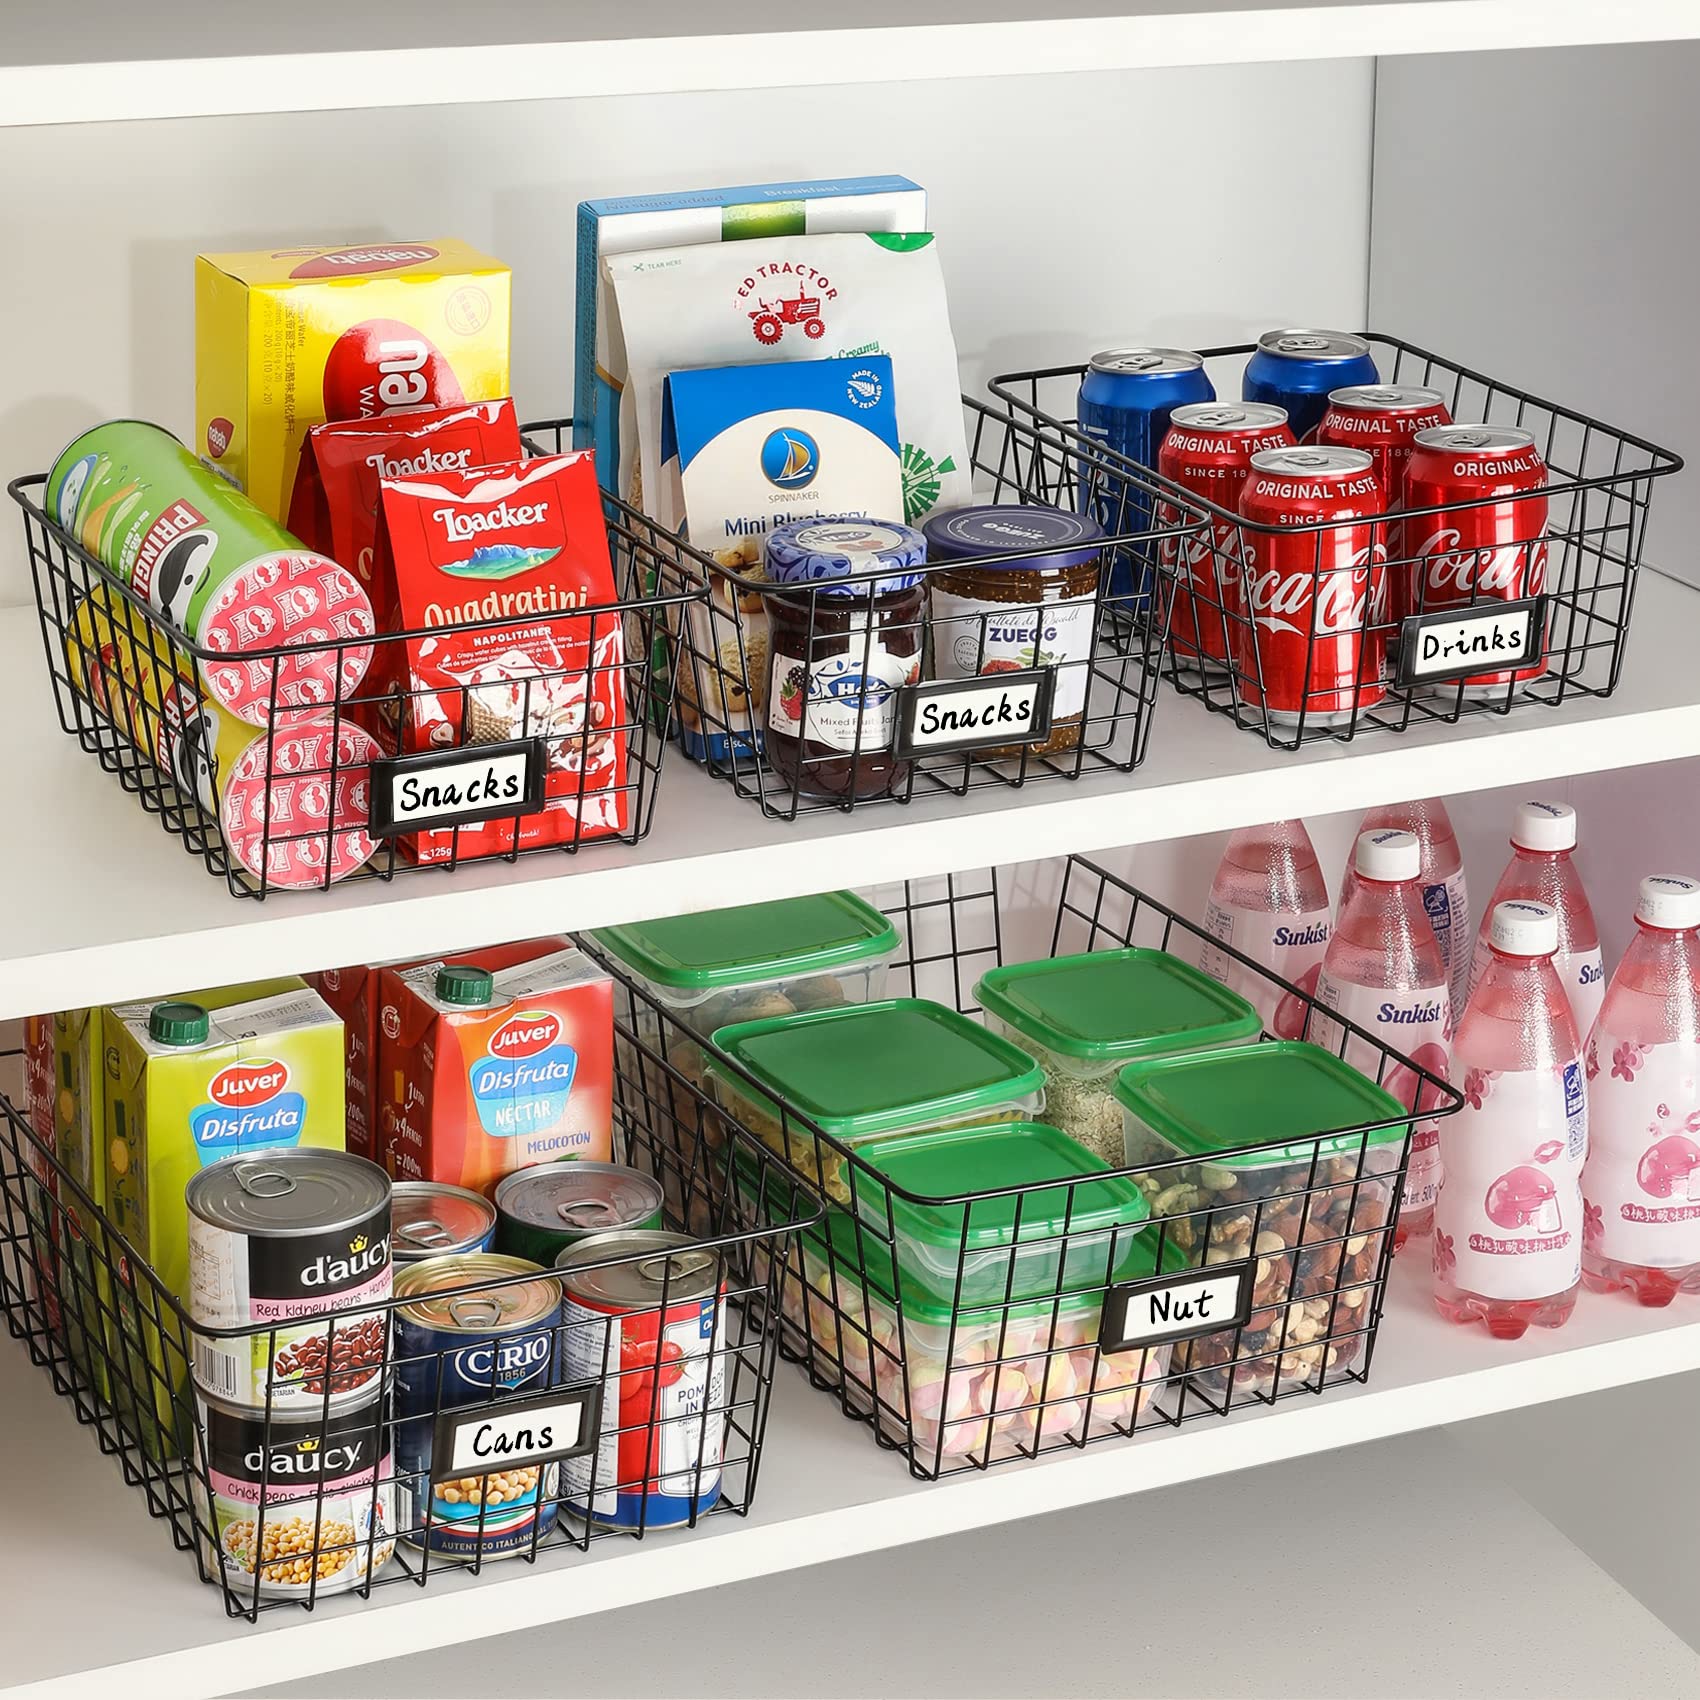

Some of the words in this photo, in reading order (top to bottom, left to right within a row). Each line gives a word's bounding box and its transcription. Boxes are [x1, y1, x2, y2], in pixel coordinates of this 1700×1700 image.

[756, 262, 838, 300] TRACTOR
[852, 370, 871, 379] MADE
[871, 374, 879, 382] IN
[859, 384, 882, 409] ZEALAND
[1325, 414, 1391, 433] ORIGINAL
[1396, 414, 1441, 433] TASTE
[1168, 433, 1236, 454] ORIGINAL
[1241, 434, 1287, 453] TASTE
[365, 448, 471, 477] Loacker
[1184, 467, 1225, 478] SINCE
[1453, 460, 1531, 476] ORIGINAL
[768, 491, 819, 504] SPINNAKER
[1256, 480, 1334, 499] ORIGINAL
[1337, 476, 1378, 497] TASTE
[433, 502, 548, 543] Loacker
[725, 516, 766, 537] Mini
[1280, 514, 1324, 524] SINCE
[133, 504, 199, 605] PRINGL
[424, 585, 588, 630] Quadratini
[473, 625, 552, 647] NAPOLITANER
[989, 627, 1058, 643] ZUEGG
[1422, 624, 1523, 661] Drinks
[820, 717, 850, 726] Mixed
[920, 692, 1031, 735] Snacks
[400, 767, 519, 811] Snacks
[1272, 922, 1327, 946] Sunkist
[1376, 1001, 1440, 1024] Sunkist
[494, 1023, 555, 1050] Juver
[216, 1072, 283, 1097] Juver
[479, 1060, 569, 1094] Disfruta
[201, 1108, 299, 1141] Disfruta
[495, 1100, 551, 1127] NÉCTAR
[527, 1130, 591, 1154] MELOCOTÓN
[301, 1233, 391, 1287] d'aucy
[256, 1304, 280, 1317] Red
[1148, 1289, 1212, 1325] Nut
[500, 1369, 526, 1382] 1856
[686, 1400, 698, 1416] IN
[473, 1424, 554, 1457] Cans
[242, 1440, 362, 1475] d'aucy
[228, 1483, 259, 1500] Chick
[441, 1540, 493, 1551] AUTENTCO
[496, 1534, 534, 1549] ITALIANO
